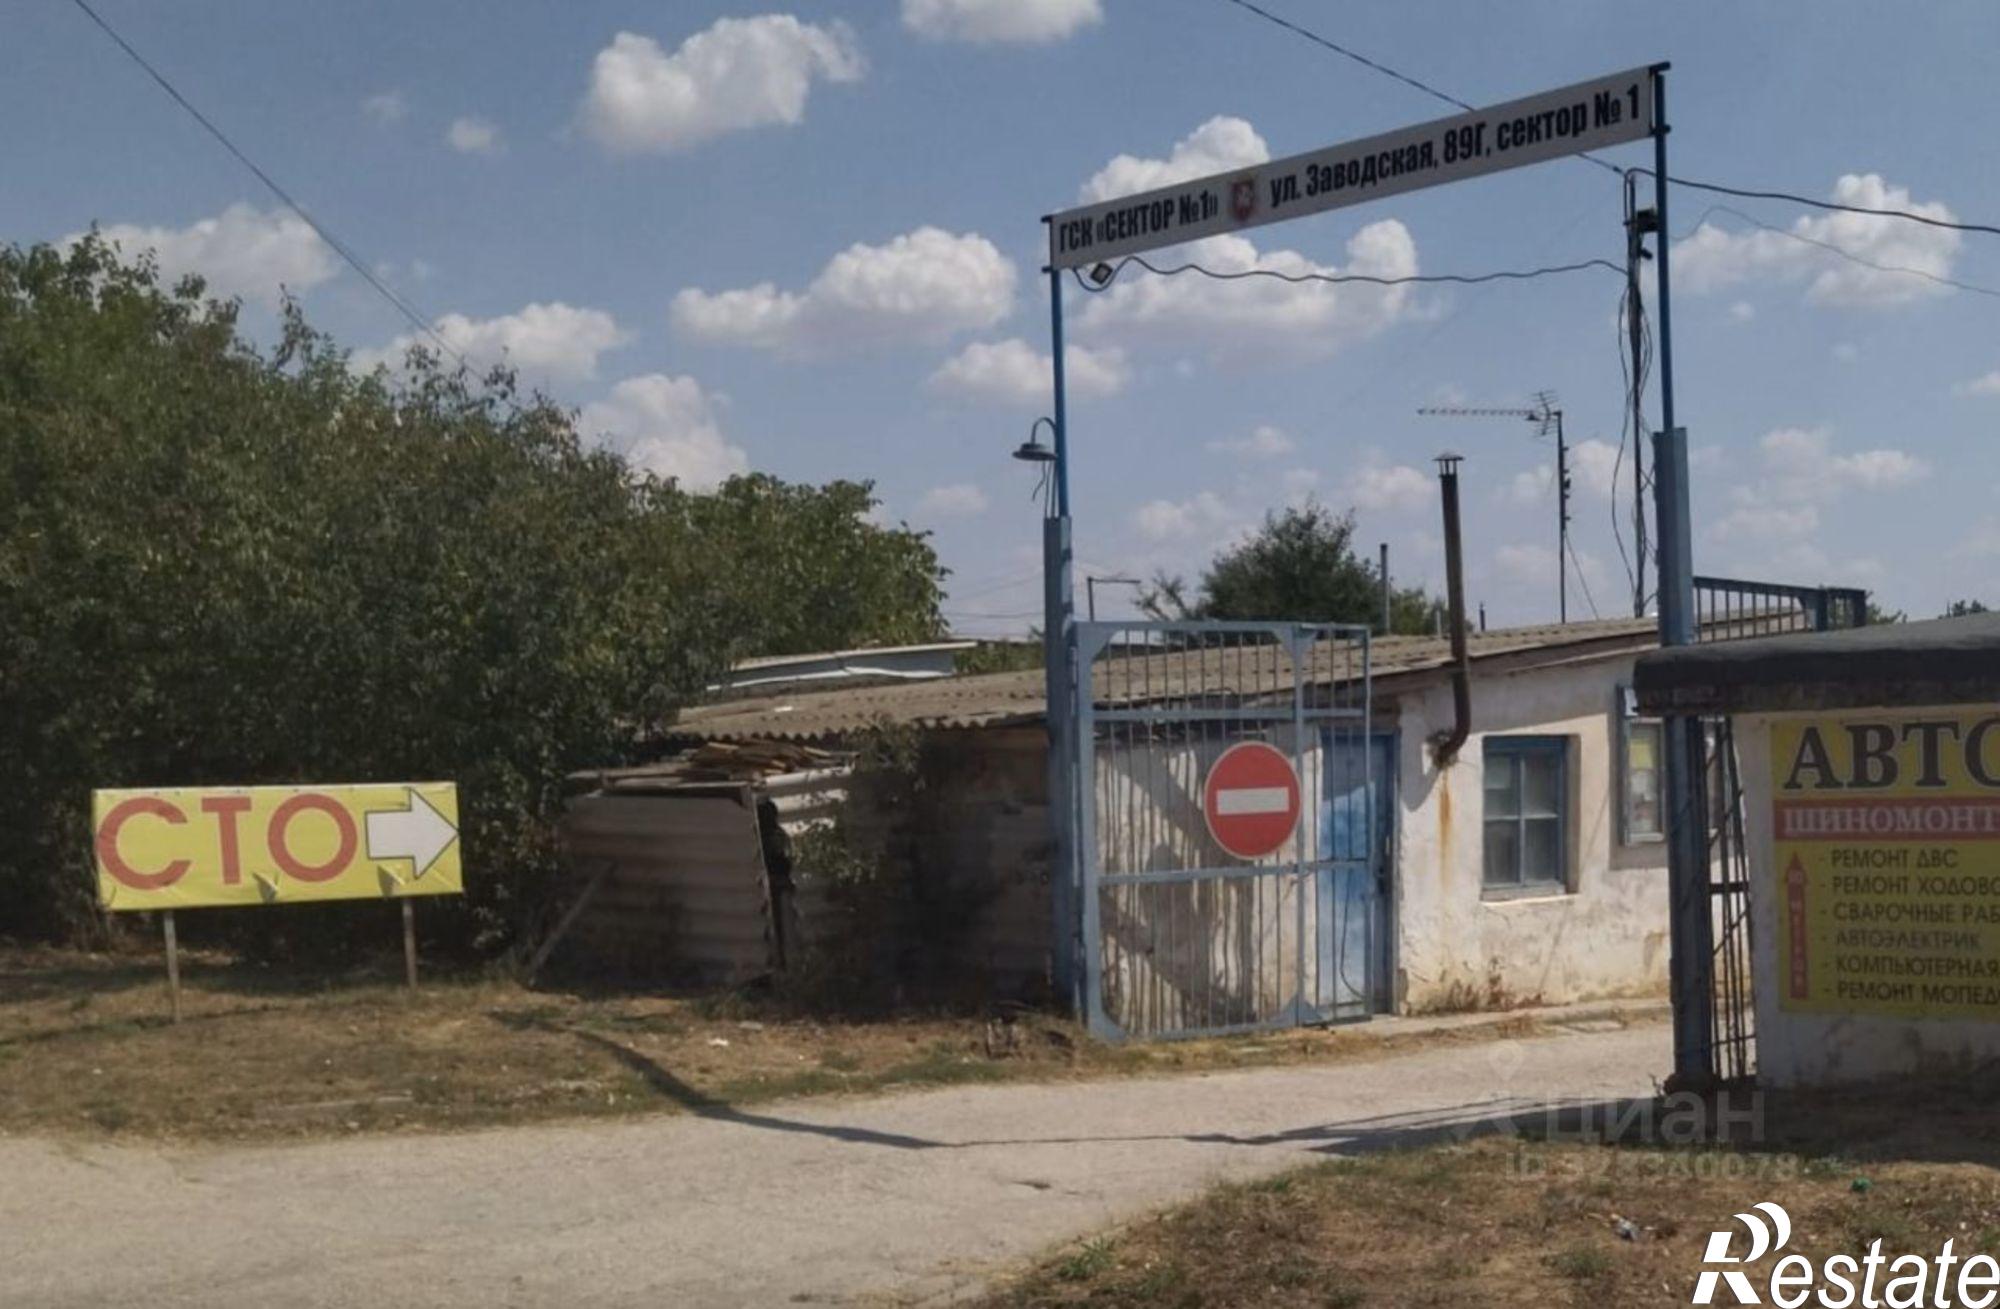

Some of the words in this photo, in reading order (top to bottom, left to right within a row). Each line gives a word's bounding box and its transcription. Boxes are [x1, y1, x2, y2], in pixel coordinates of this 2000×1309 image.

[1060, 217, 1093, 253] ГСК
[1270, 174, 1301, 209] ул.
[1306, 141, 1439, 197] Заводская,
[1443, 122, 1491, 164] 89Г,
[1497, 102, 1587, 150] сектор
[1627, 83, 1640, 119] 1
[94, 792, 359, 891] СТО
[1831, 849, 1909, 869] РЕМОНТ
[1916, 848, 1960, 869] ДВС
[1832, 875, 1909, 895] РЕМОНТ
[1833, 901, 1956, 923] СВАРОЧНЫЕ
[1836, 929, 1982, 951] АВТОЭЛЕКТРИК
[1835, 954, 2000, 978] КОМПЬЮТЕРНАЯ
[1837, 980, 1915, 1000] РЕМОНТ
[1921, 983, 2000, 1005] МОПЕД
